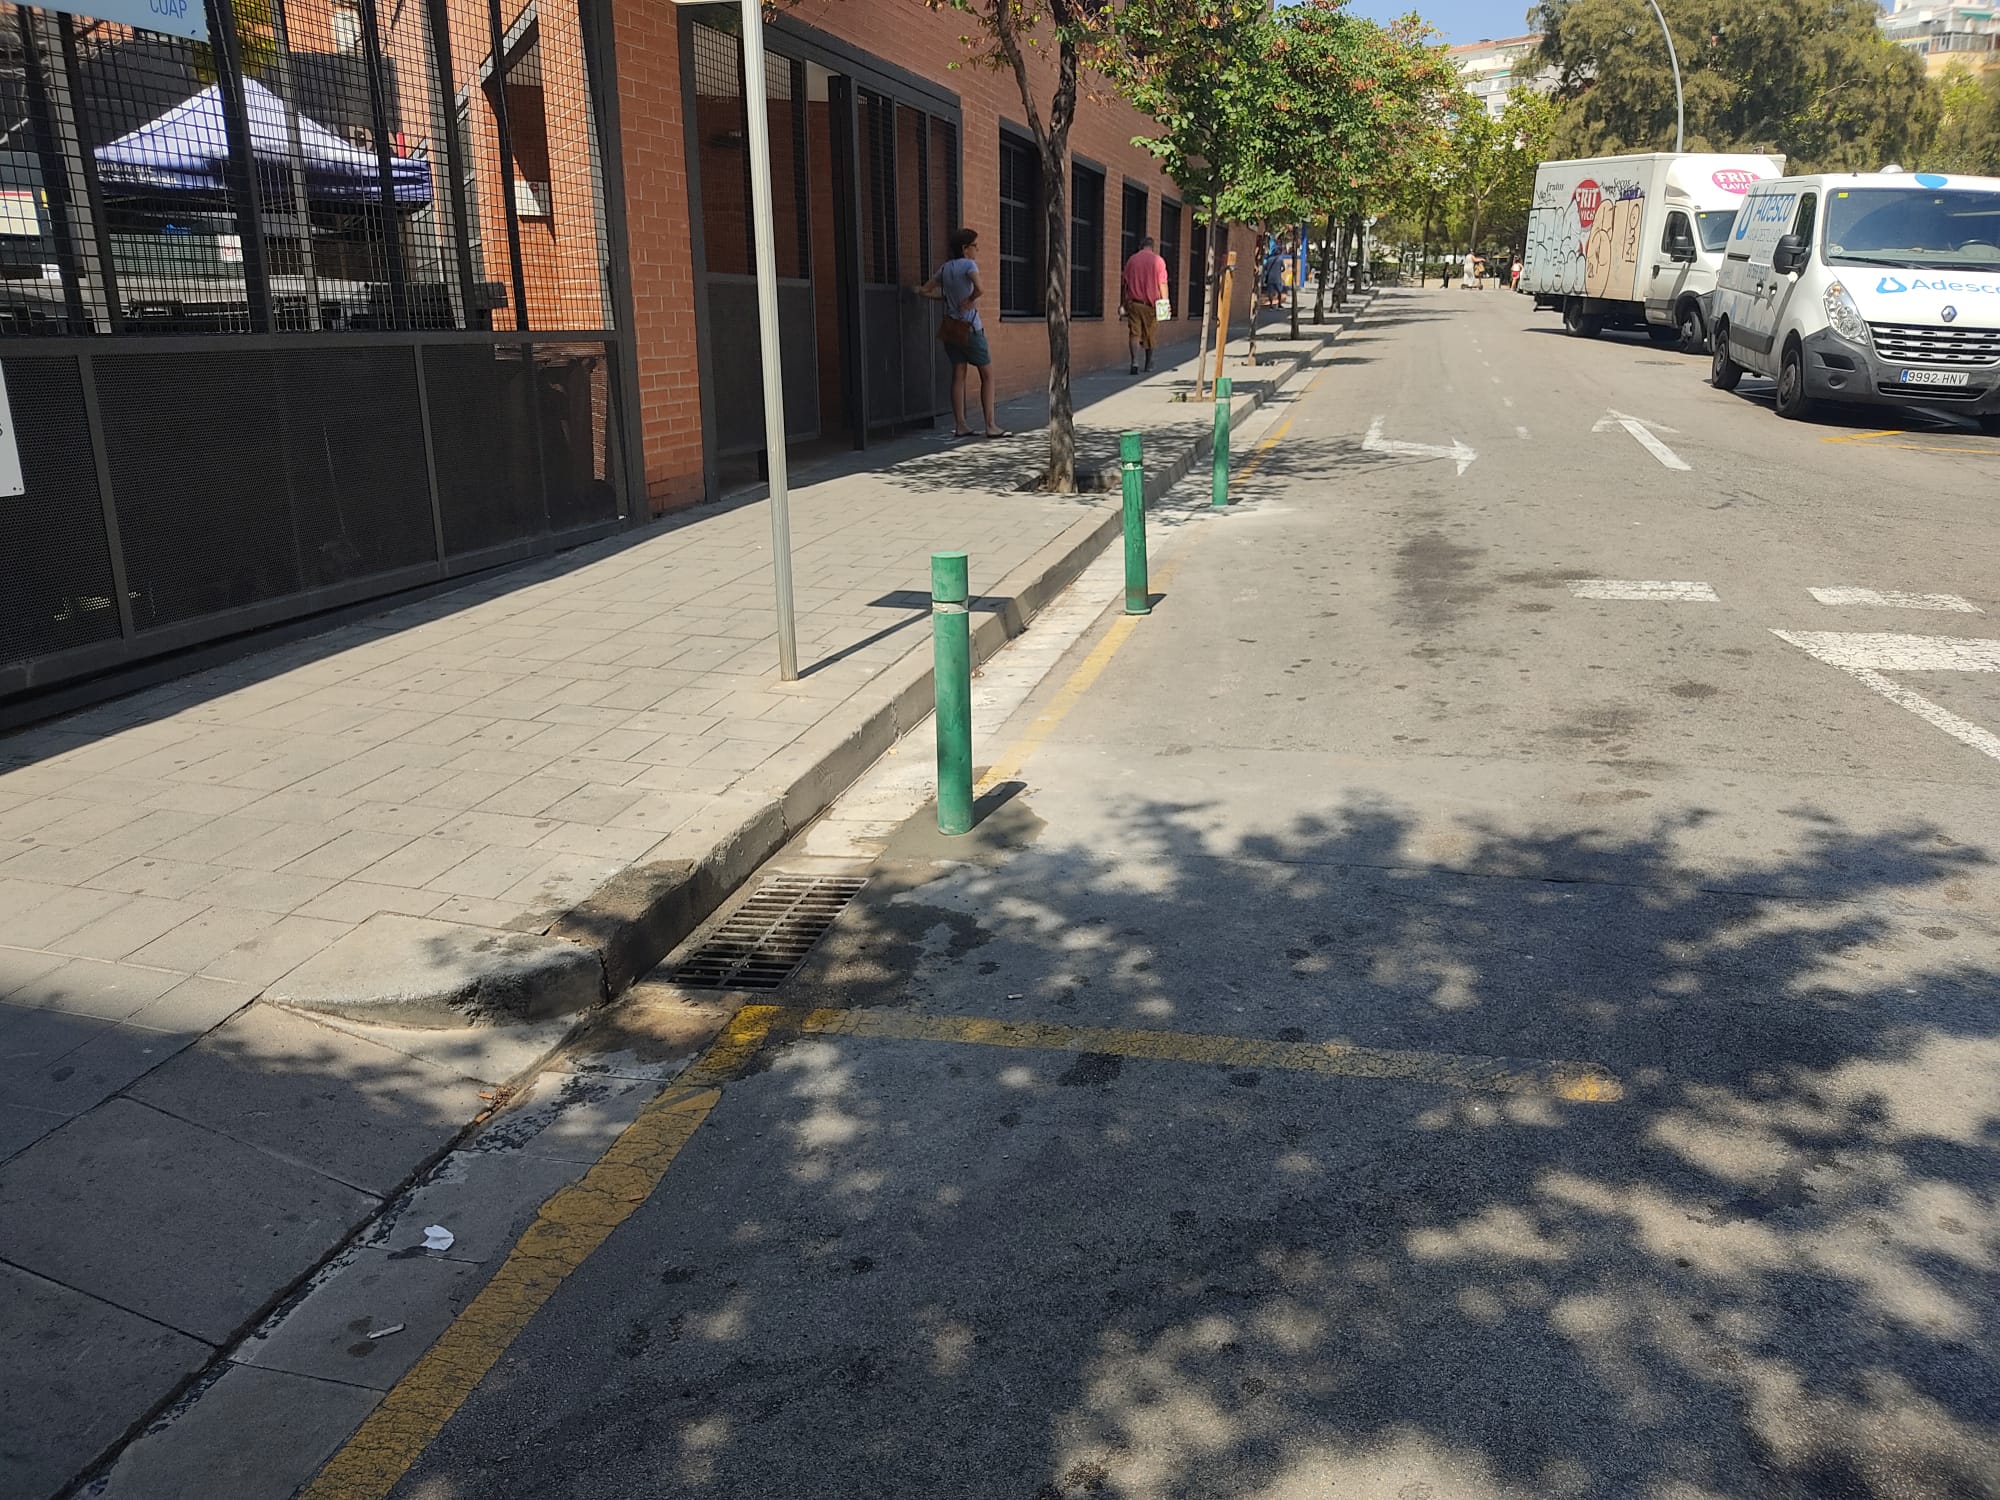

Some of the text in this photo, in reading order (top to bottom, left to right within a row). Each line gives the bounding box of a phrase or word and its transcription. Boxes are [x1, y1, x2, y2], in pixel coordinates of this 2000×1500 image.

[1716, 172, 1755, 183] FRIT
[1575, 187, 1599, 208] FRIT
[1753, 187, 1796, 222] Adesco
[1908, 371, 1967, 385] 9992 HNV
